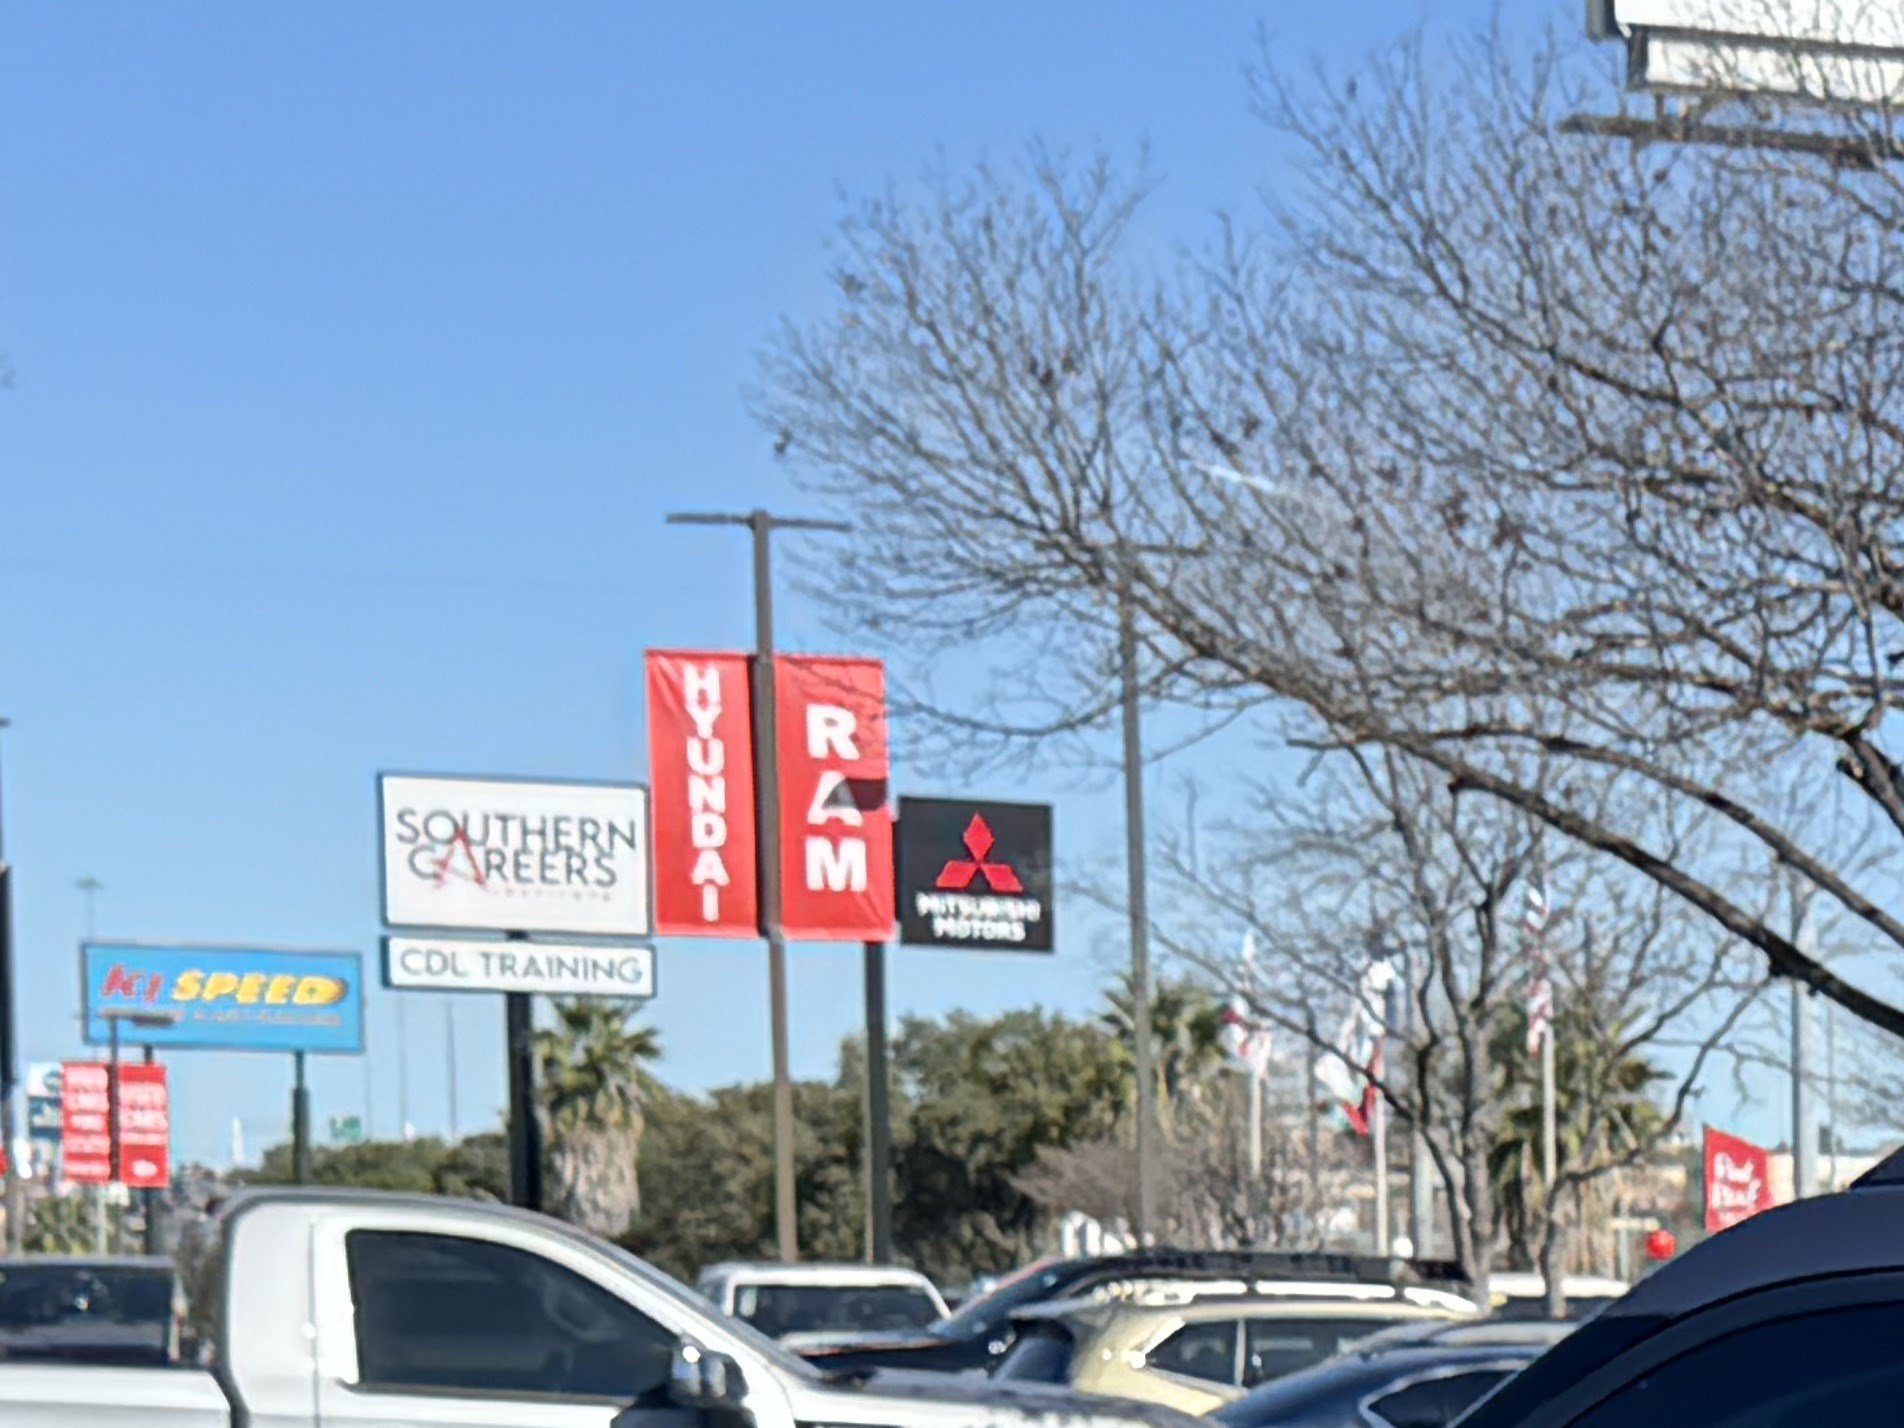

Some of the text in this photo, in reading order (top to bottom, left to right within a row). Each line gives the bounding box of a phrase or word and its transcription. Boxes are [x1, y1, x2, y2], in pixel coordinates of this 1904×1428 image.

[683, 662, 730, 923] HYUNDAI
[804, 702, 868, 894] RAM
[396, 808, 638, 855] SOUTHERN
[407, 832, 618, 889] CAREERS
[915, 891, 1042, 922] MITSUBISHI
[933, 916, 1027, 942] MOTORS
[400, 947, 644, 985] CDL TRAINING
[171, 969, 350, 1006] SPEED
